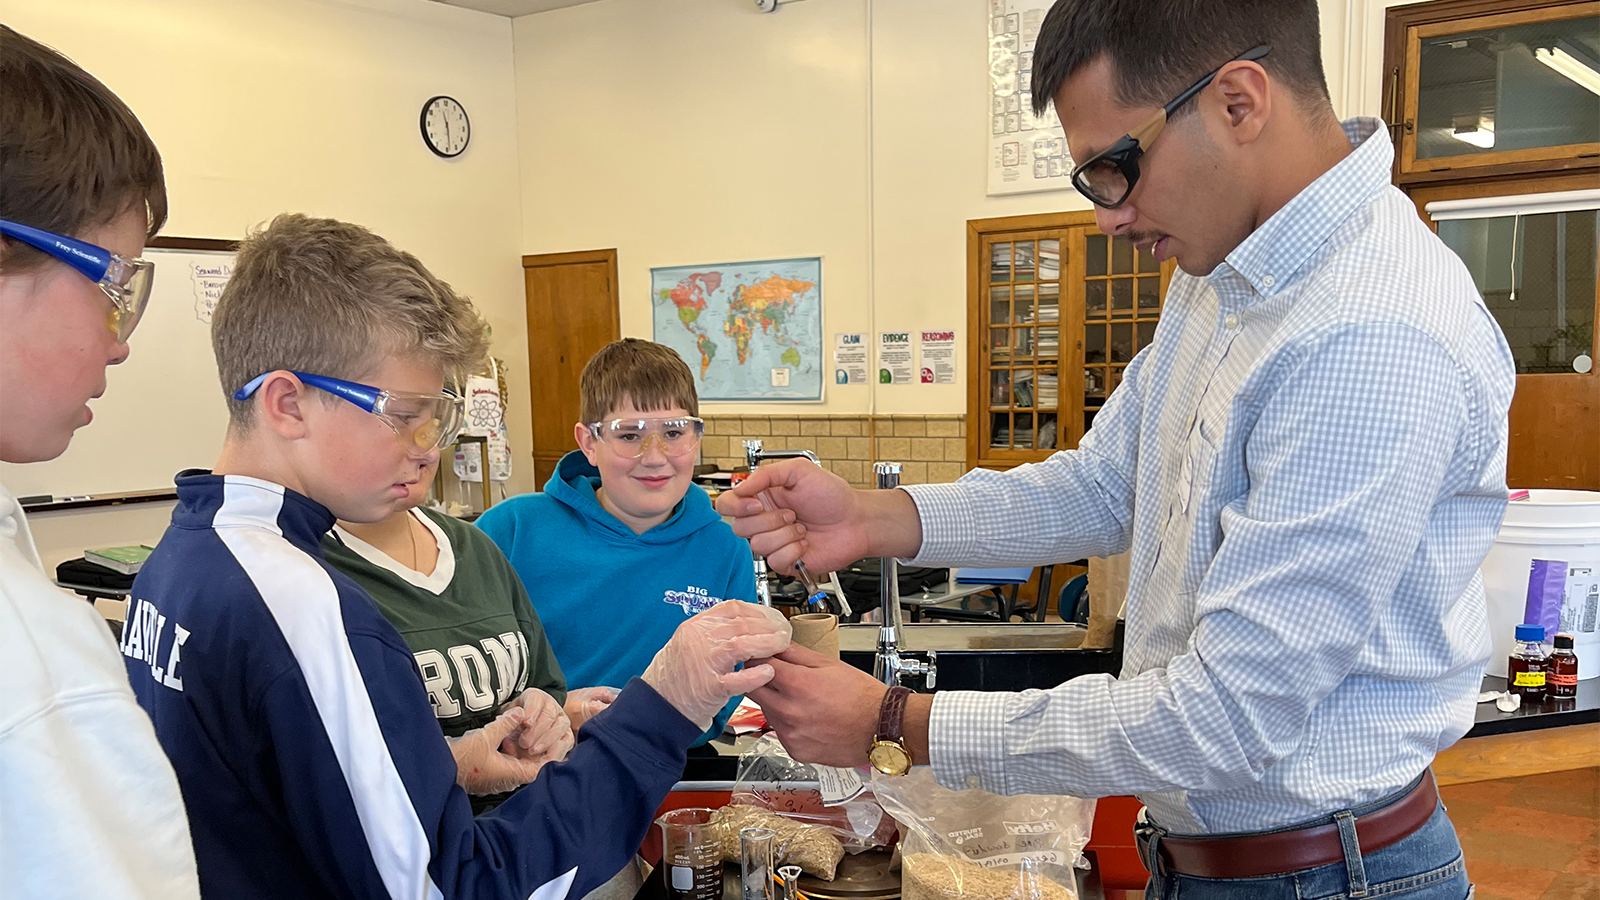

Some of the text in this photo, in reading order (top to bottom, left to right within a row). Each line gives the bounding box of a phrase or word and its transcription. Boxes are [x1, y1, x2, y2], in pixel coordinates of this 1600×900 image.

[55, 241, 102, 264] Frey Scientific
[195, 265, 222, 275] Seaweed
[842, 334, 861, 344] CLAIM
[882, 333, 909, 343] EVIDENCE
[921, 331, 955, 342] REASONING
[687, 585, 708, 596] BIG
